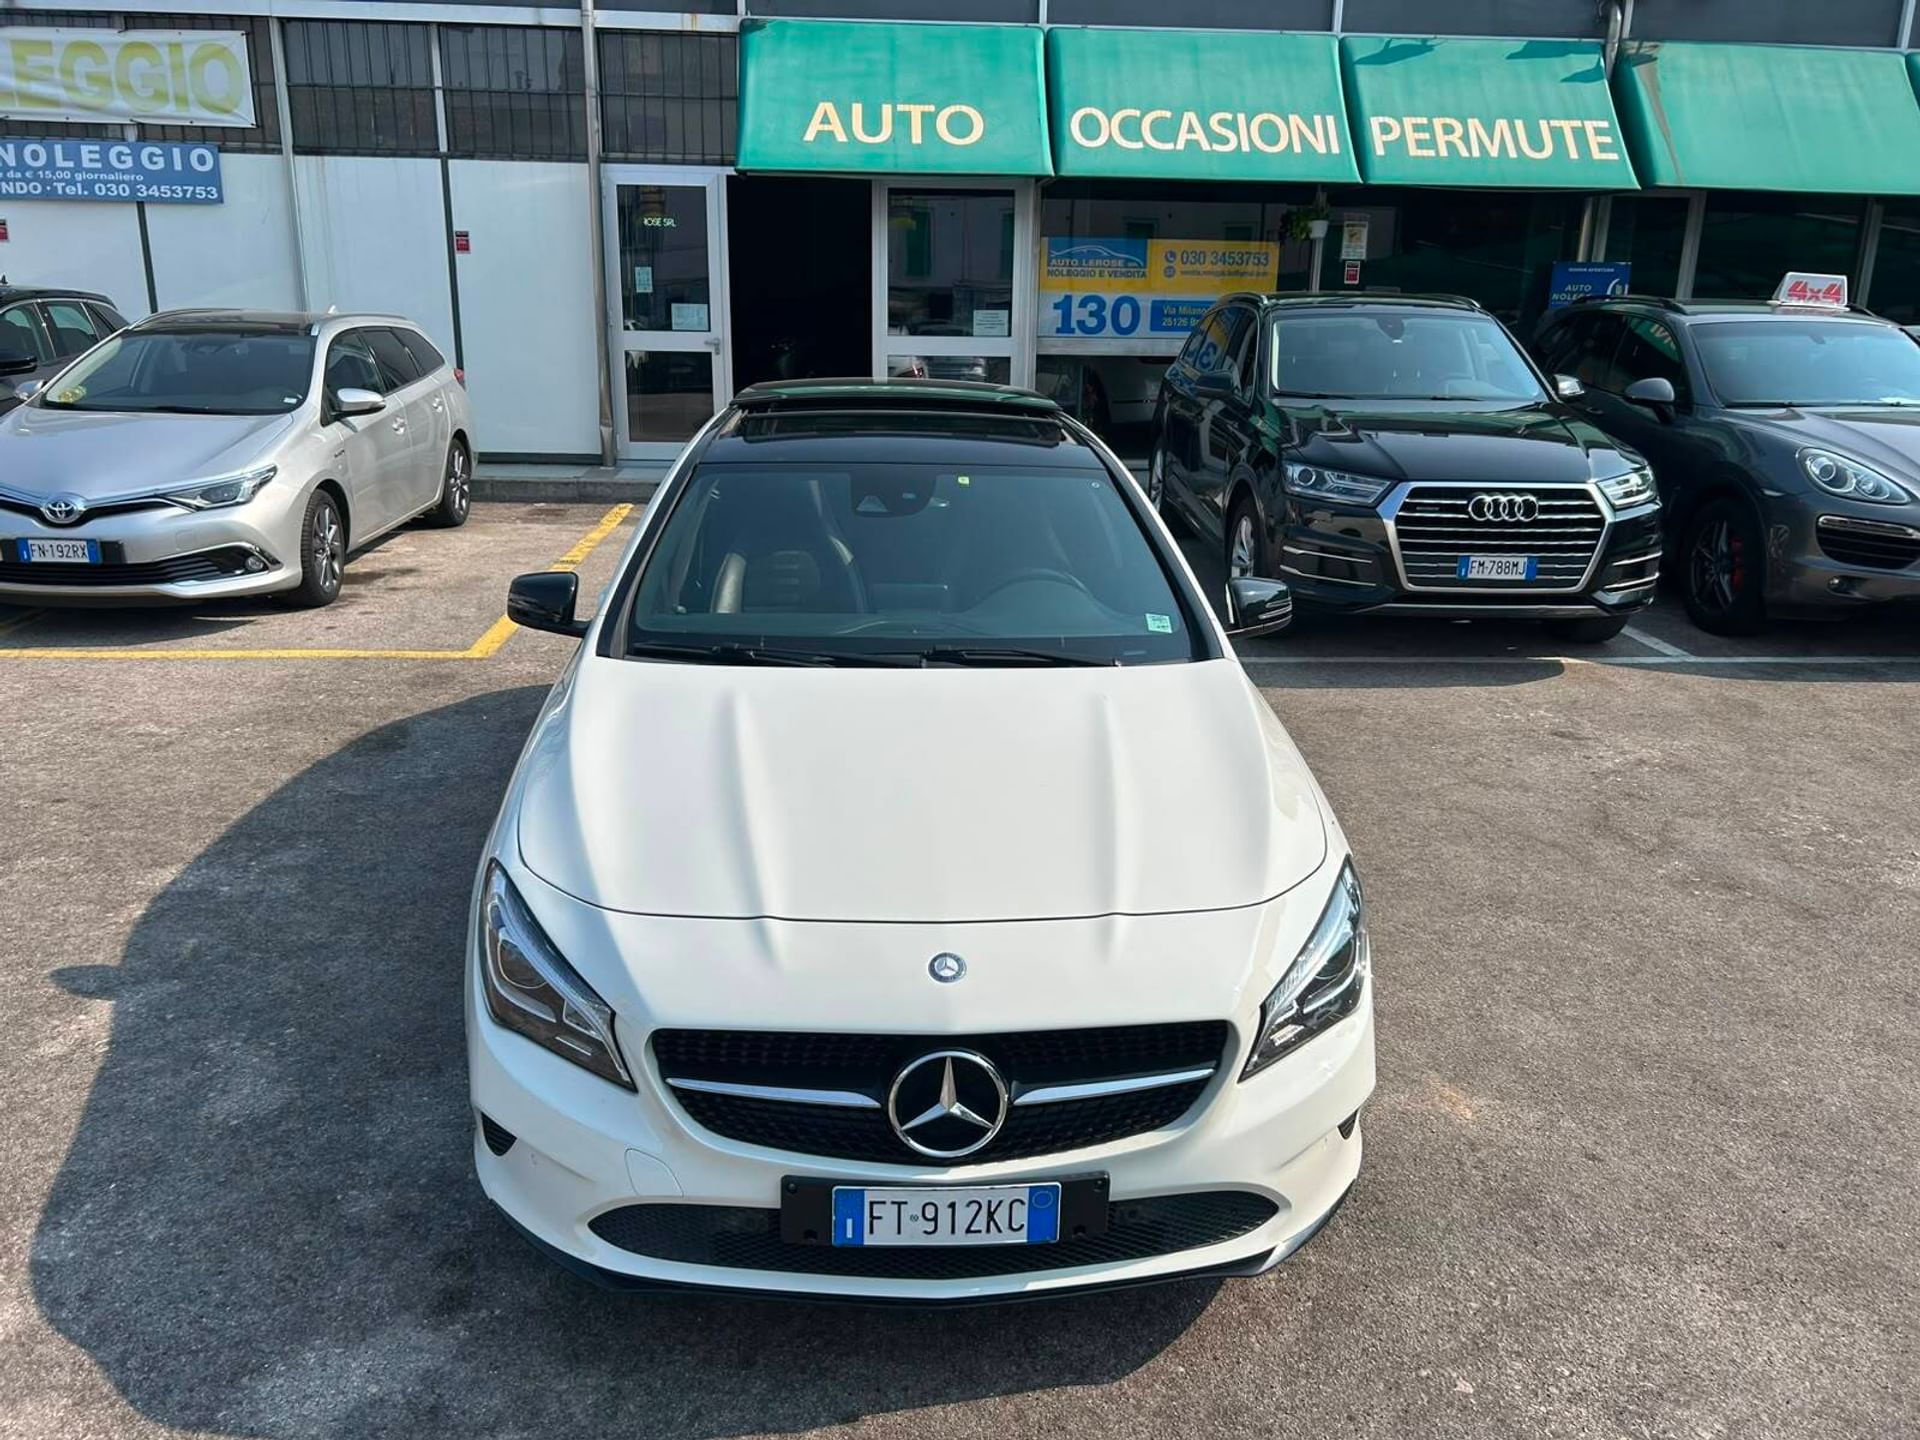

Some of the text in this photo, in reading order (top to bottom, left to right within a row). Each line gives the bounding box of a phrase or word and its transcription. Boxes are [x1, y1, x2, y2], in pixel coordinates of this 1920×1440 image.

[802, 101, 1619, 161] AUTO OCCASIONI PERMUTE
[6, 170, 22, 178] da
[25, 171, 34, 179] €
[37, 170, 71, 180] 15,00
[74, 171, 144, 182] giornaliero
[53, 182, 89, 196] Tel.
[94, 183, 130, 197] 030
[136, 184, 218, 200] 3453753
[1051, 258, 1079, 267] AUTO
[1180, 250, 1270, 267] 030 3453753
[1048, 268, 1096, 278] NOLEGGIO
[1107, 268, 1147, 279] VENDITA
[1564, 284, 1592, 292] AUTO
[1787, 280, 1842, 304] 4x4
[1053, 294, 1141, 336] 130
[1162, 304, 1177, 316] Via
